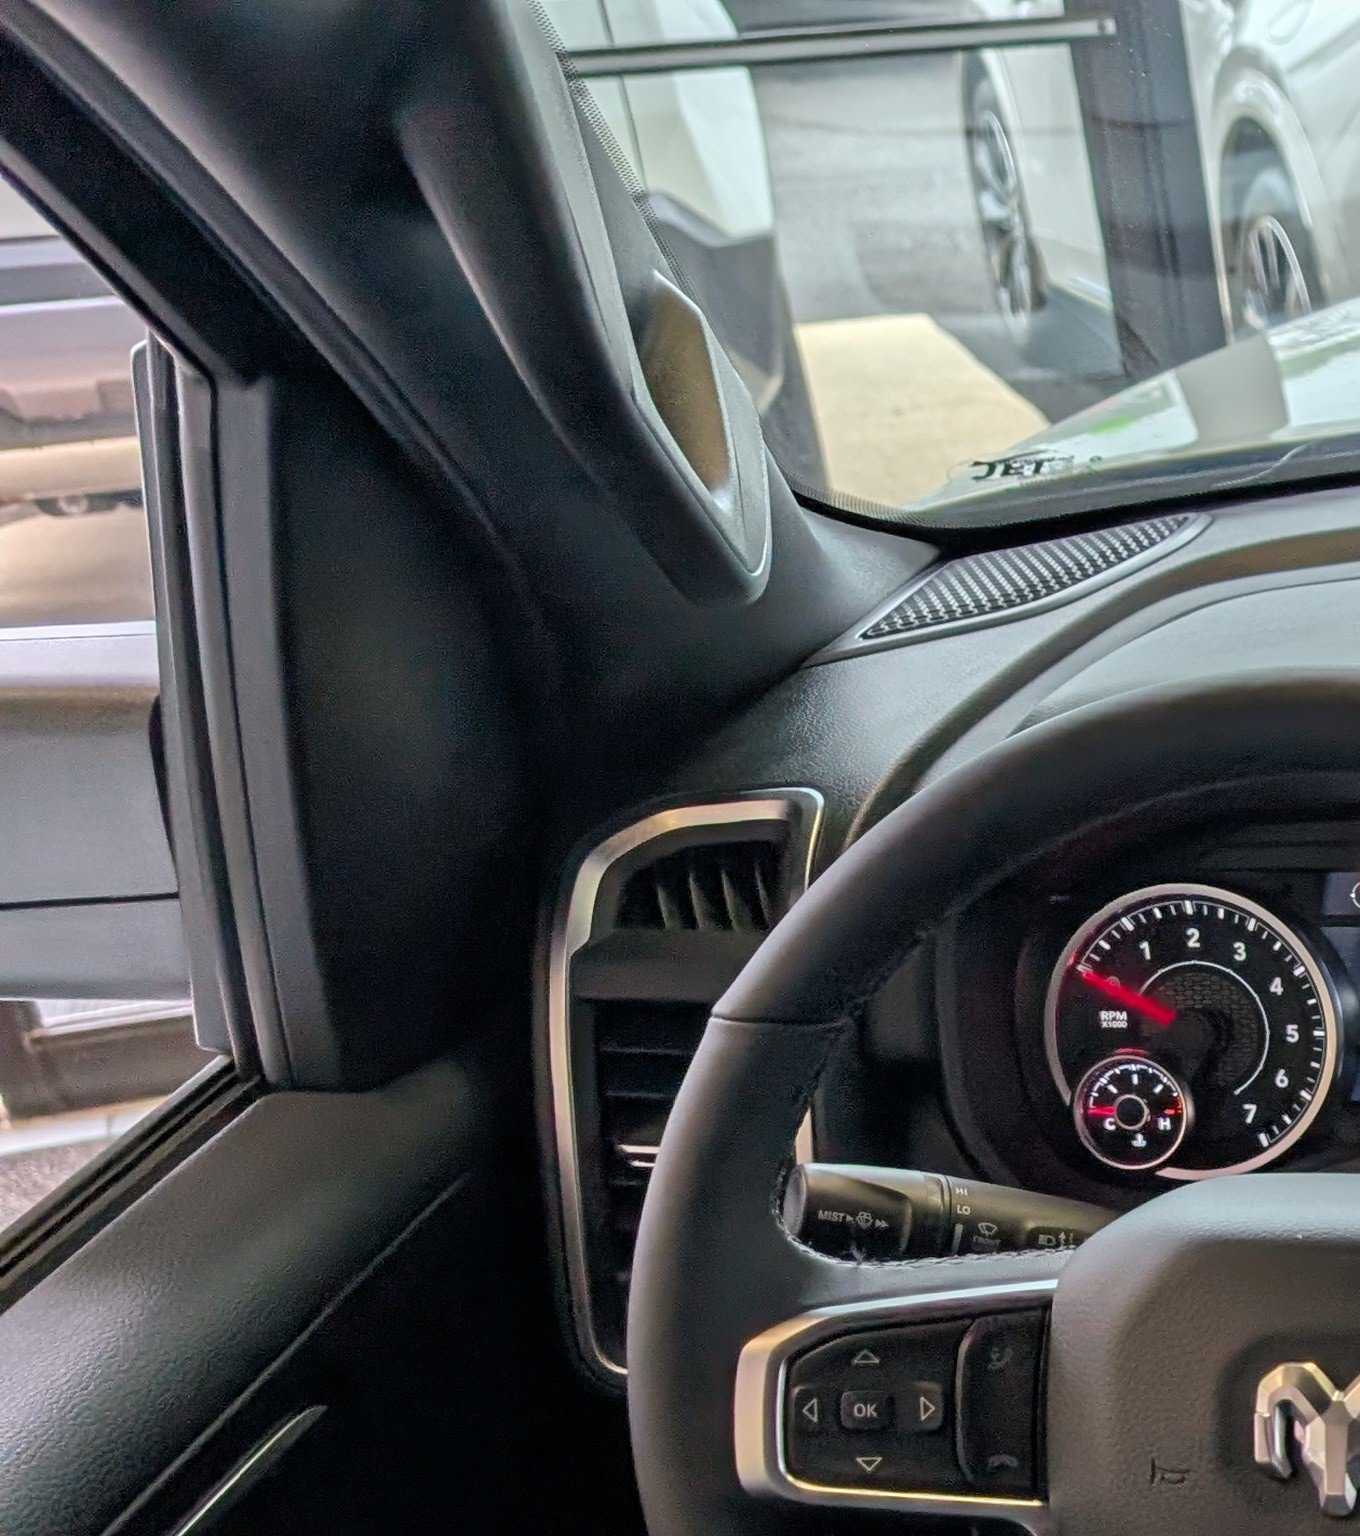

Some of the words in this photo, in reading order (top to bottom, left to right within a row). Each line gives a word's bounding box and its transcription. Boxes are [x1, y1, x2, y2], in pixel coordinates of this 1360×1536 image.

[1185, 927, 1201, 948] 2
[1139, 941, 1151, 960] 1
[1233, 941, 1247, 961] 3
[1269, 976, 1284, 995] 4
[1100, 1010, 1128, 1020] RPM
[1285, 1024, 1299, 1043] 5
[1275, 1068, 1289, 1088] 6
[1242, 1103, 1258, 1124] 7
[1103, 1118, 1117, 1131] C
[1157, 1117, 1171, 1131] H
[955, 1187, 969, 1197] HI
[818, 1209, 845, 1223] MIST
[956, 1205, 971, 1215] LO
[853, 1402, 878, 1418] OK
